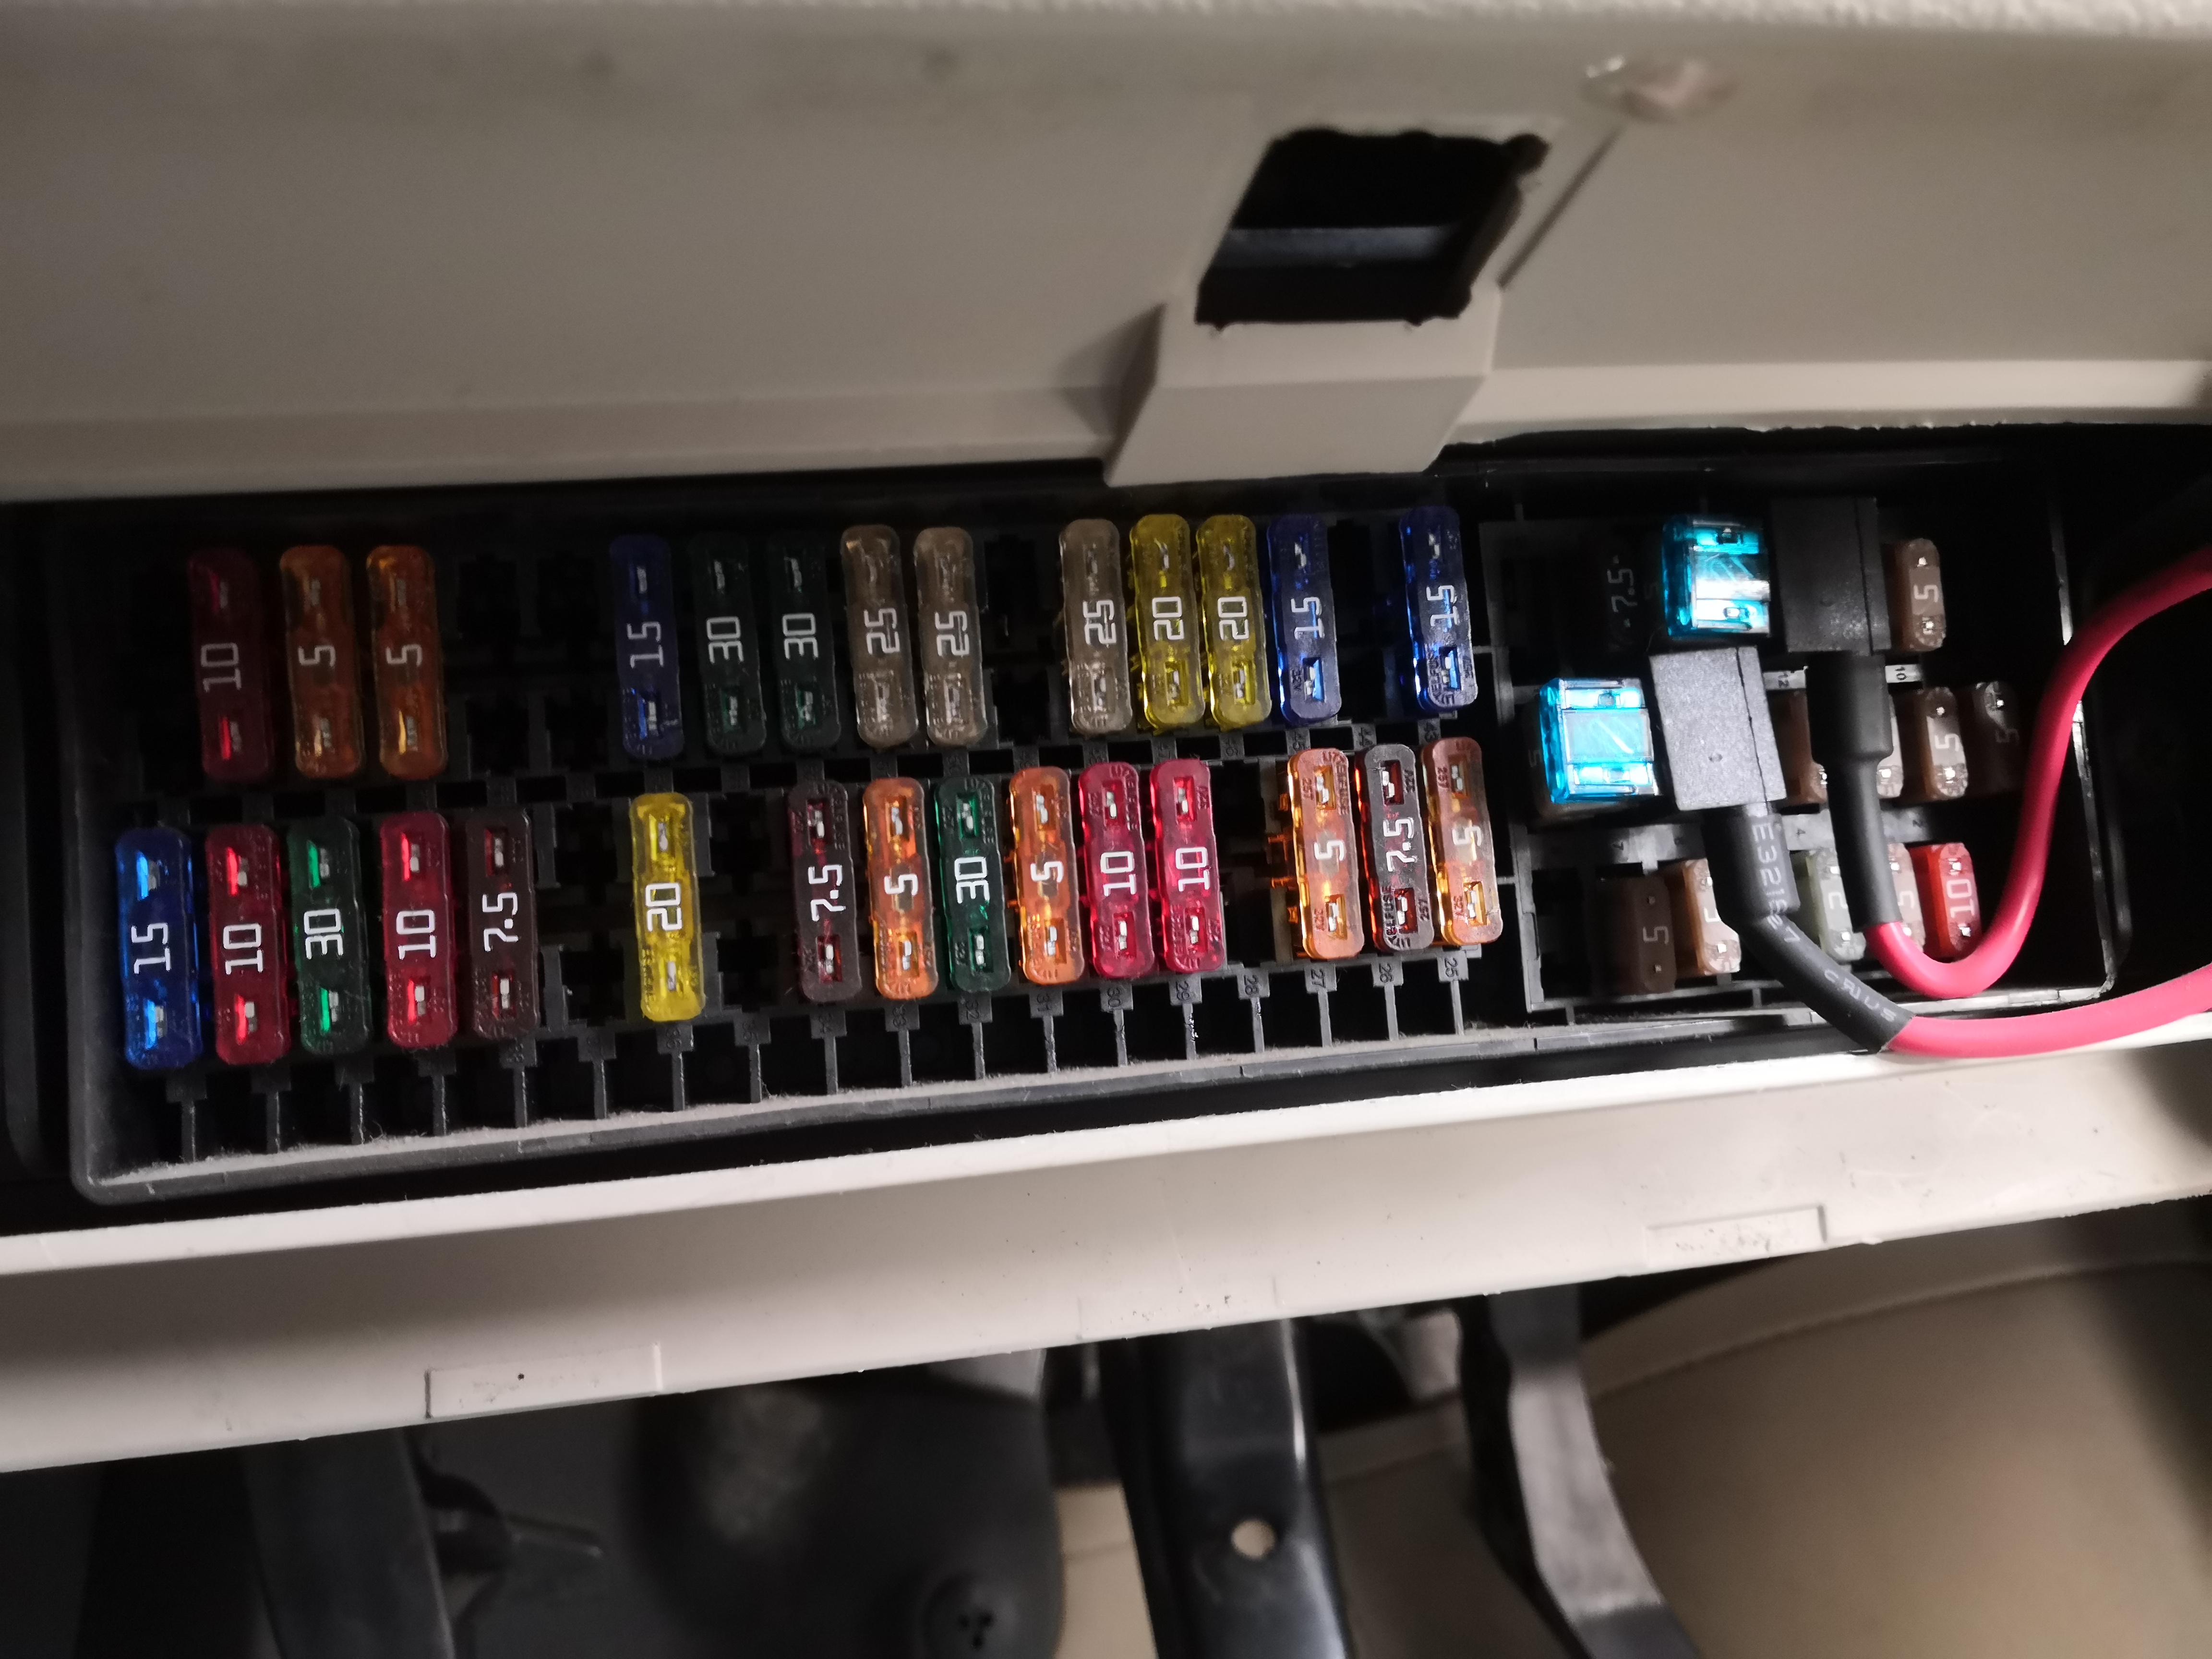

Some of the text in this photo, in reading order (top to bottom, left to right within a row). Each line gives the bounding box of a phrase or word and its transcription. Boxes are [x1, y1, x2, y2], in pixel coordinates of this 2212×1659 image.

[1426, 585, 1460, 626] 15
[1913, 584, 1938, 602] 5
[864, 608, 900, 655] 25
[935, 610, 970, 657] 25
[1082, 600, 1116, 645] 25
[1152, 596, 1184, 641] 20
[1217, 596, 1249, 640] 20
[1290, 597, 1325, 639] 15
[626, 622, 664, 669] 15
[706, 616, 744, 664] 30
[782, 613, 819, 660] 30
[200, 642, 241, 693] 10
[298, 645, 336, 668] 5
[385, 644, 422, 666] 5
[1895, 666, 1907, 680] 10
[1293, 732, 1306, 750] 45
[1359, 728, 1372, 745] 44
[1424, 722, 1437, 742] 43
[1935, 733, 1959, 751] 5
[1383, 817, 1417, 872] 7.5
[1452, 825, 1481, 846] 5
[1796, 828, 1806, 836] 4
[1314, 839, 1344, 861] 5
[885, 874, 918, 895] 5
[954, 857, 990, 903] 30
[1030, 861, 1063, 882] 5
[1101, 851, 1136, 896] 10
[1176, 847, 1210, 892] 10
[645, 882, 682, 931] 20
[808, 865, 846, 921] 7.5
[1946, 879, 1975, 918] 10
[303, 908, 344, 960] 30
[396, 909, 436, 960] 10
[482, 892, 518, 952] 7.5
[1642, 926, 1670, 944] 5
[131, 923, 171, 974] 15
[223, 923, 263, 975] 10
[1310, 969, 1325, 989] 27
[1379, 963, 1395, 983] 26
[1444, 958, 1459, 978] 25
[1107, 987, 1121, 1008] 30
[1176, 981, 1190, 1001] 29
[1243, 974, 1258, 995] 28
[892, 1007, 907, 1028] 33
[965, 1000, 979, 1020] 32
[1037, 994, 1050, 1012] 31
